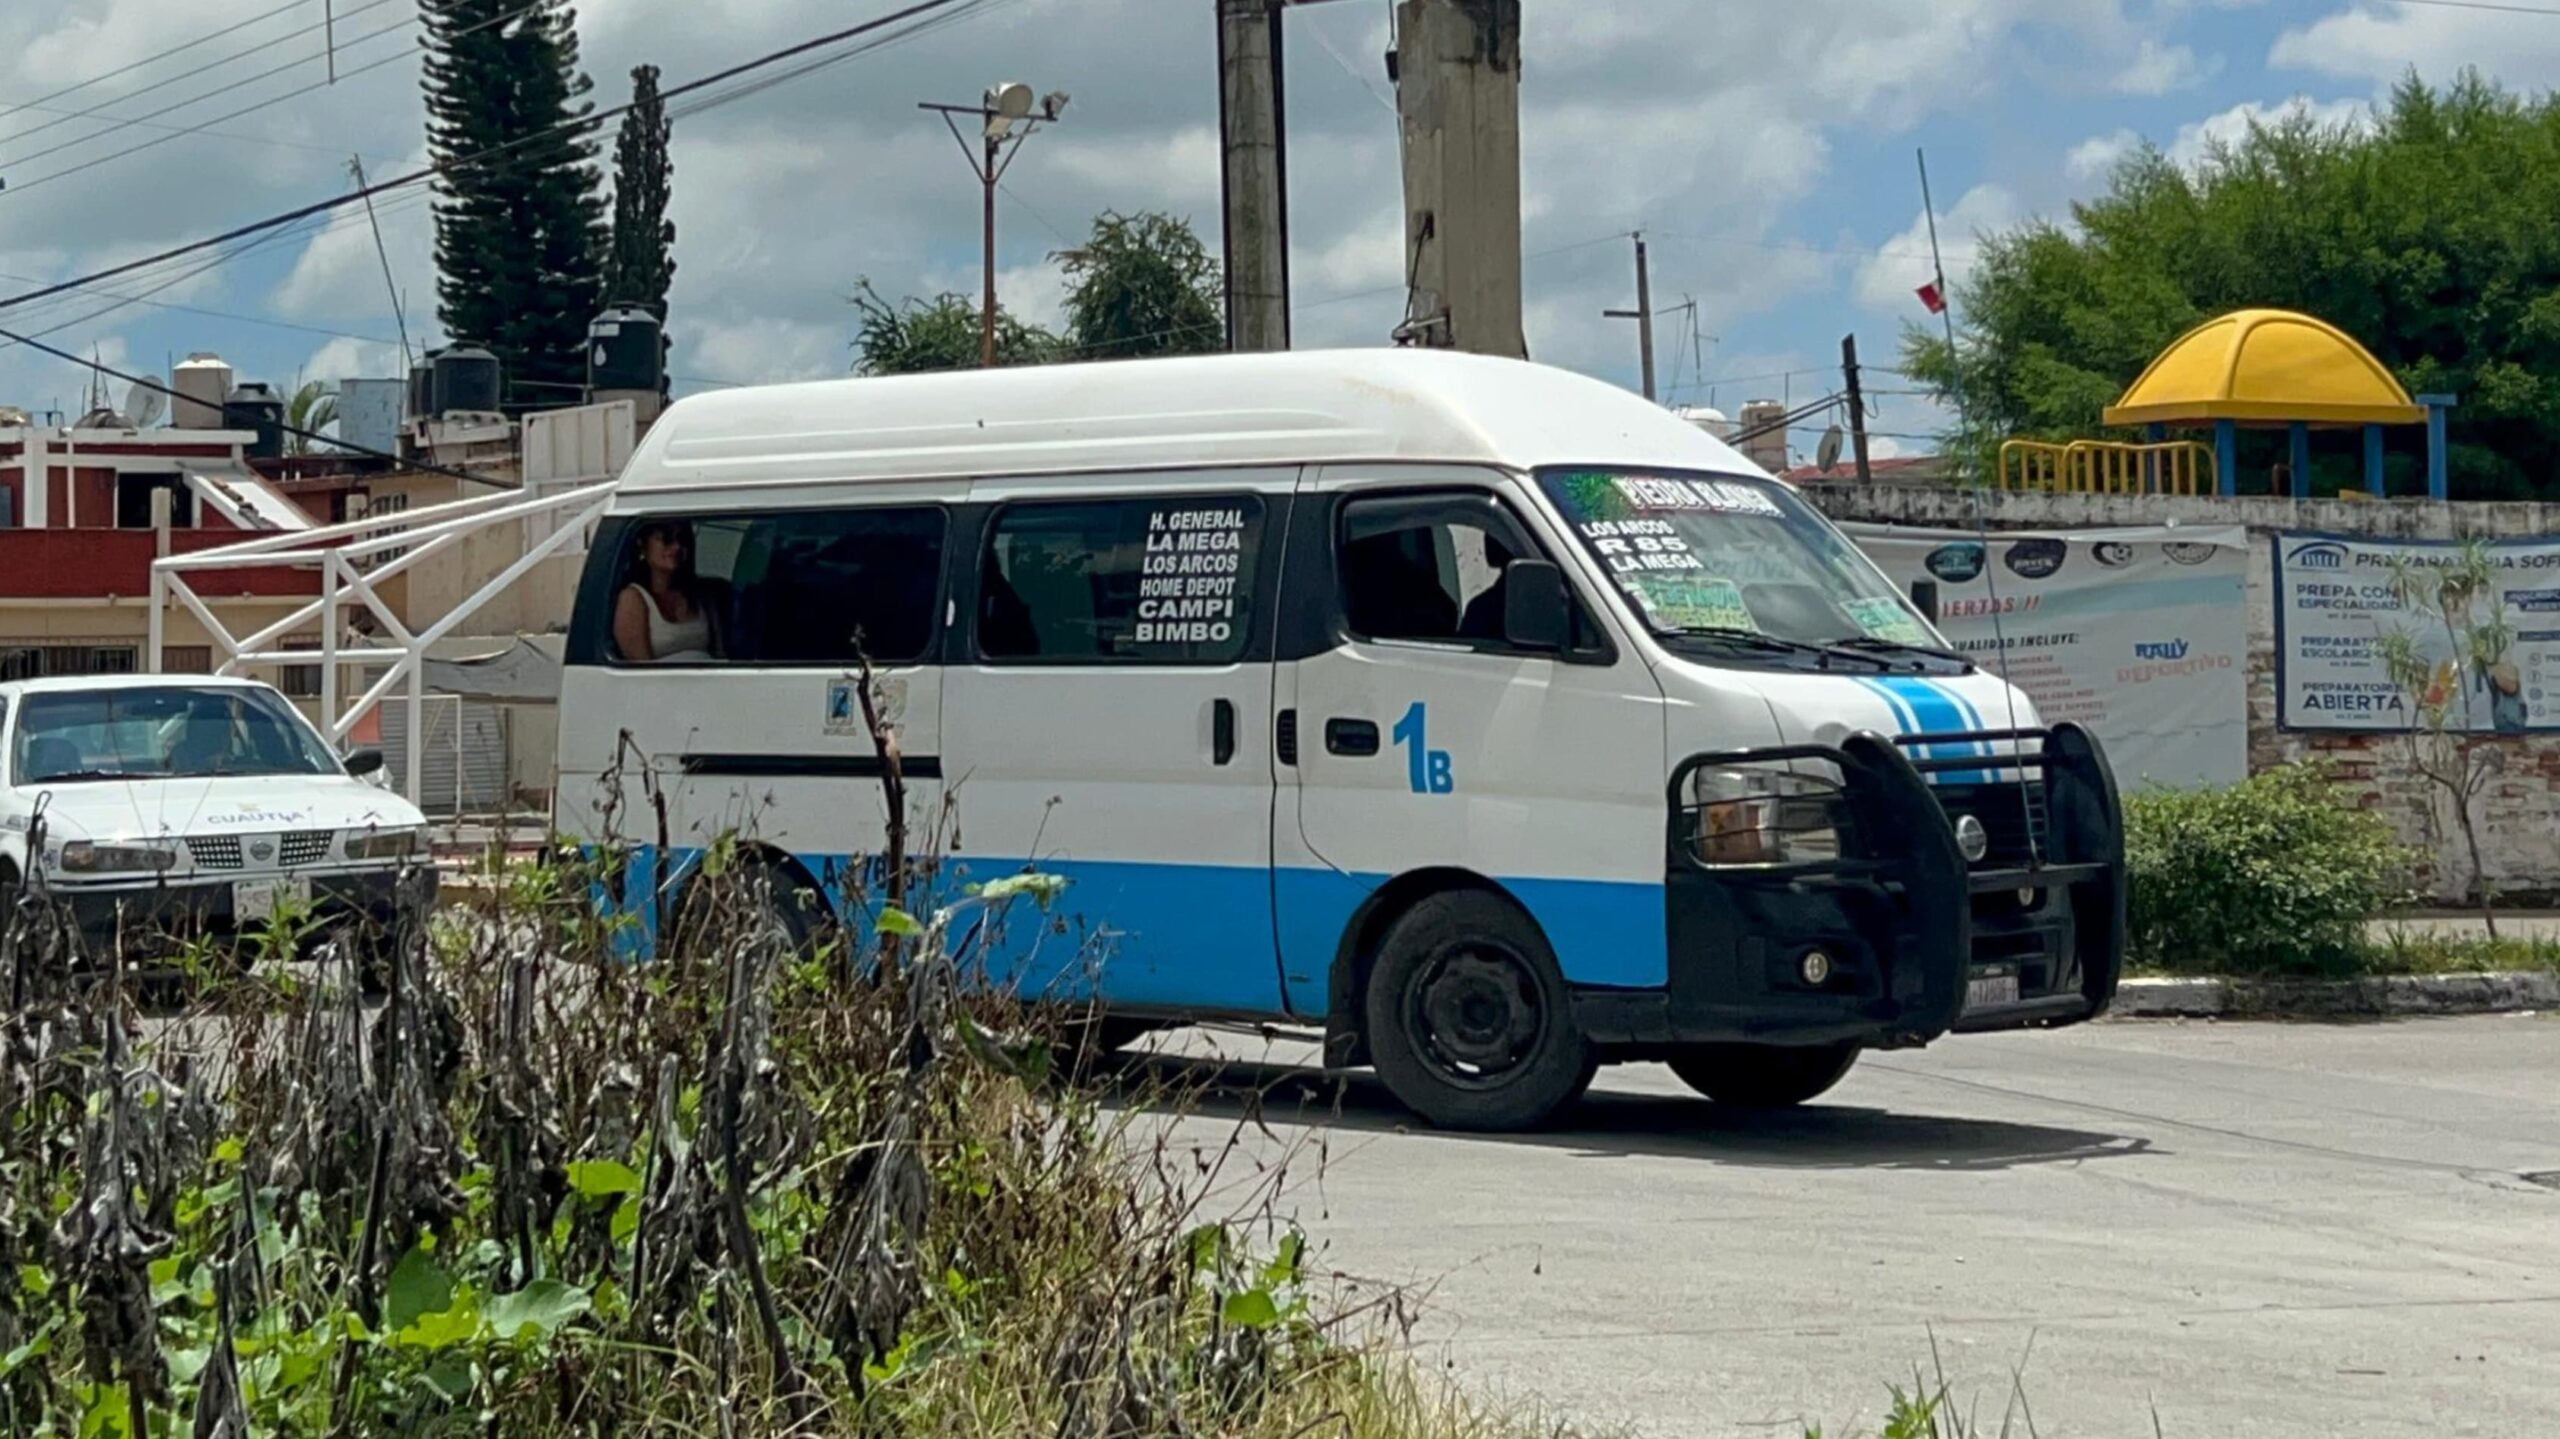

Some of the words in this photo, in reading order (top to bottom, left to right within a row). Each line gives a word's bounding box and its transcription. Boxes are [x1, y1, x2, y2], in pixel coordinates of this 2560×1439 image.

[1150, 512, 1166, 530] H.
[1169, 510, 1244, 530] GENERAL
[1580, 521, 1618, 538] LOS
[1617, 520, 1674, 535] ARCOS
[1146, 533, 1173, 551] LA
[1178, 531, 1240, 551] MEGA
[1594, 539, 1633, 554] R
[1635, 537, 1688, 551] 85
[1143, 555, 1177, 574] LOS
[1178, 554, 1238, 573] ARCOS
[1608, 555, 1643, 572] LA
[1639, 554, 1703, 570] MEGA
[2520, 555, 2560, 568] SOF
[1140, 578, 1183, 597] HOME
[1186, 577, 1236, 597] DEPOT
[2297, 584, 2357, 597] PREPA
[1138, 599, 1234, 619] CAMPI
[2298, 598, 2401, 610] ESPECIALIDAD
[1135, 622, 1231, 642] BIMBO
[2020, 633, 2079, 648] INCLUYE:
[2134, 638, 2189, 659] RALLY
[2116, 653, 2232, 683] DEPORTIVO
[2303, 694, 2404, 710] ABIERTA
